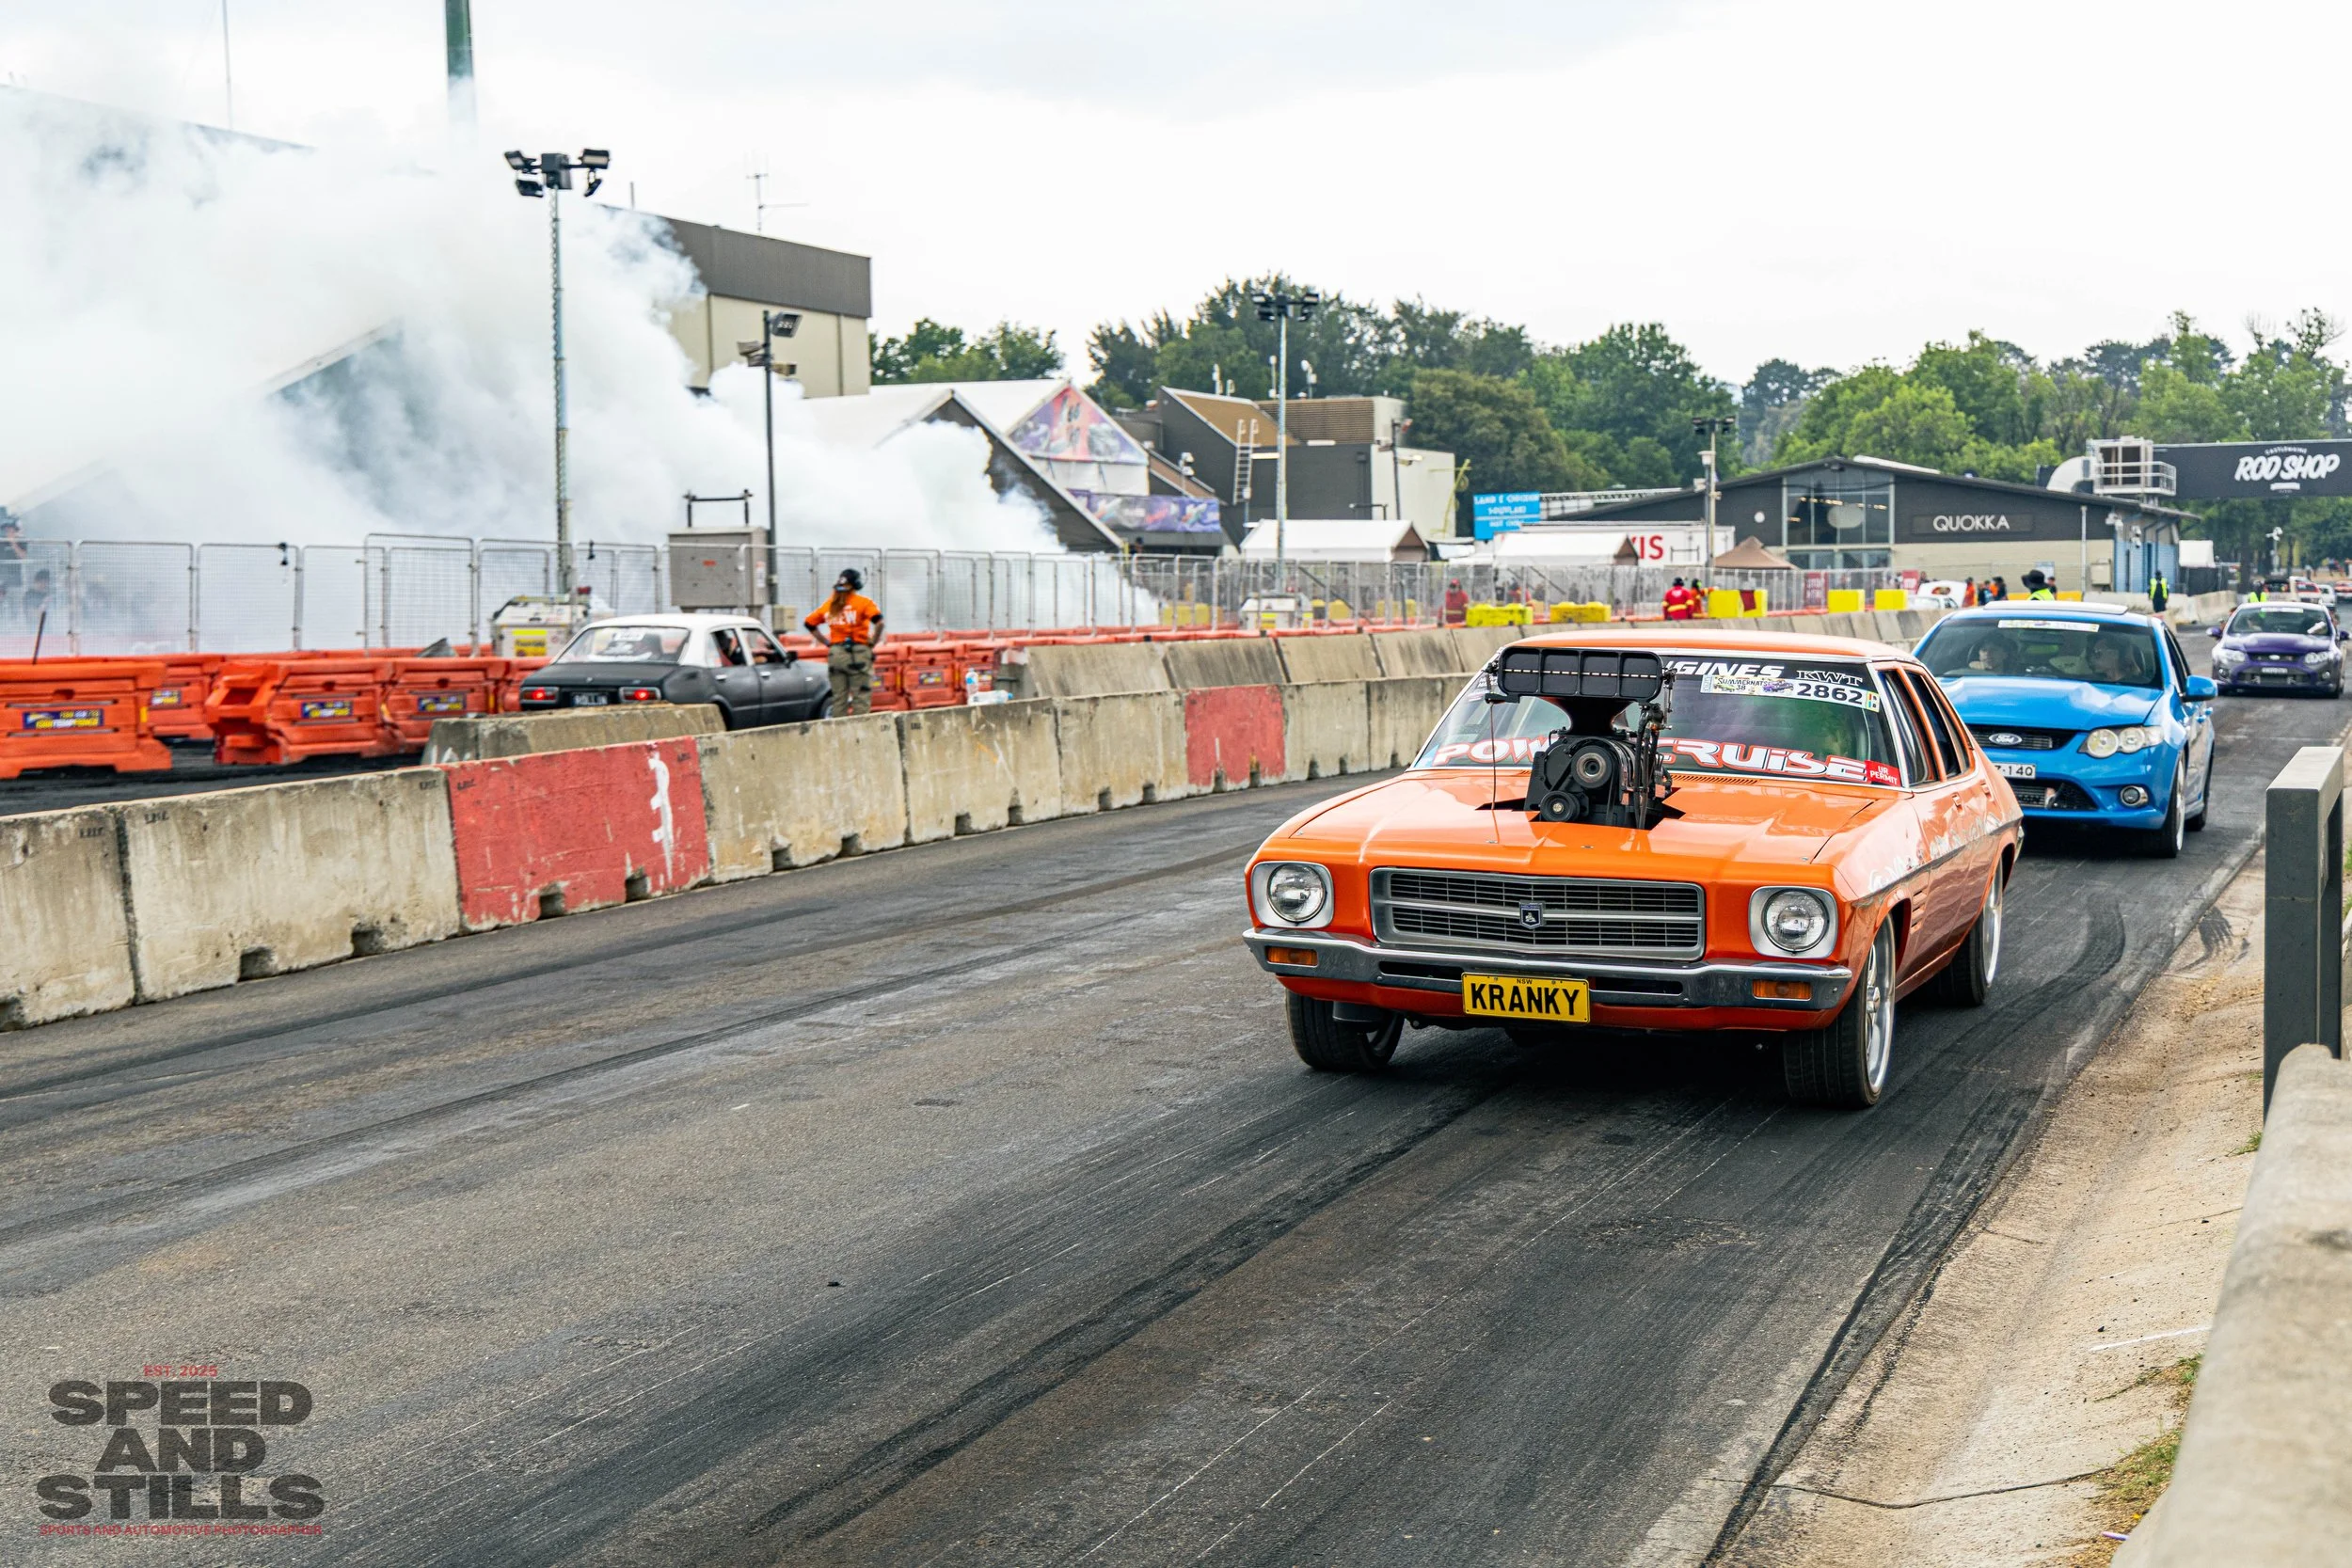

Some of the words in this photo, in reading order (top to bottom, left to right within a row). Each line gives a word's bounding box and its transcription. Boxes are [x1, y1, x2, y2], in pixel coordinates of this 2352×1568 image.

[2234, 455, 2281, 482] ROD
[2280, 453, 2341, 480] SHOP
[1932, 515, 2010, 531] QUOKKA
[1631, 534, 1663, 560] IS
[1796, 670, 1864, 687] KWT
[1797, 683, 1863, 705] 2862
[1869, 769, 1899, 784] PERMIT
[1878, 766, 1889, 775] UR
[1470, 983, 1580, 1015] KRANKY
